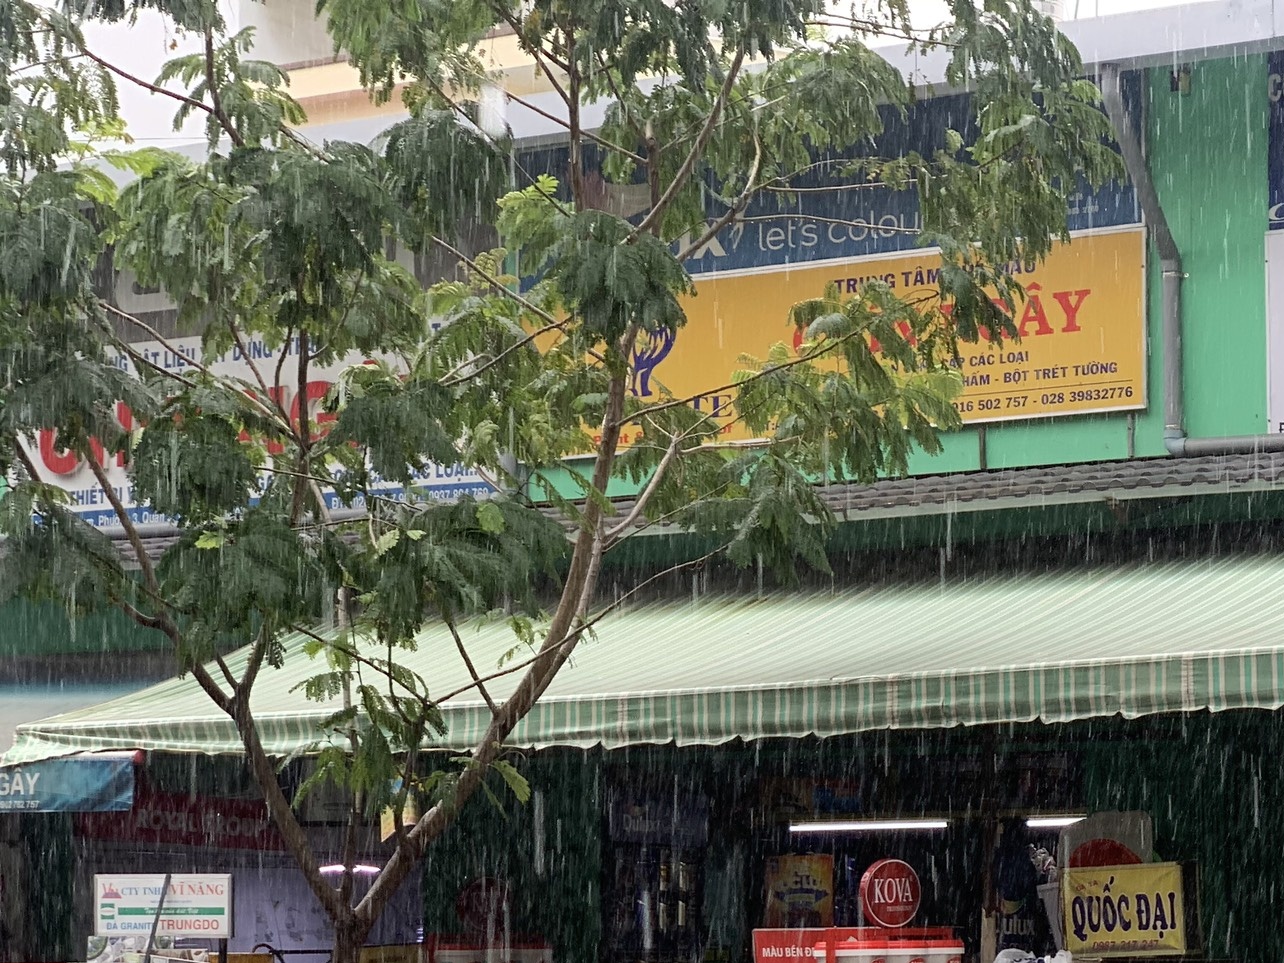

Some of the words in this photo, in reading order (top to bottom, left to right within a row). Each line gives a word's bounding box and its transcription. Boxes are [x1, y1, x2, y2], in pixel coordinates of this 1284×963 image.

[970, 351, 995, 366] CÁC
[999, 349, 1030, 367] LOẠI
[1003, 370, 1030, 386] BỘT
[1034, 365, 1069, 380] TRÉT
[1072, 361, 1119, 377] TƯỜNG
[978, 399, 1002, 411] 502
[1005, 395, 1028, 408] 757
[1041, 392, 1065, 405] 028
[1068, 386, 1133, 402] 39832776
[121, 886, 141, 896] CTY
[873, 877, 914, 904] KOVA
[1072, 875, 1132, 942] QUỐC
[1135, 891, 1177, 939] ĐẠI
[160, 919, 220, 931] TRUNGDO
[762, 942, 783, 957] MÀU
